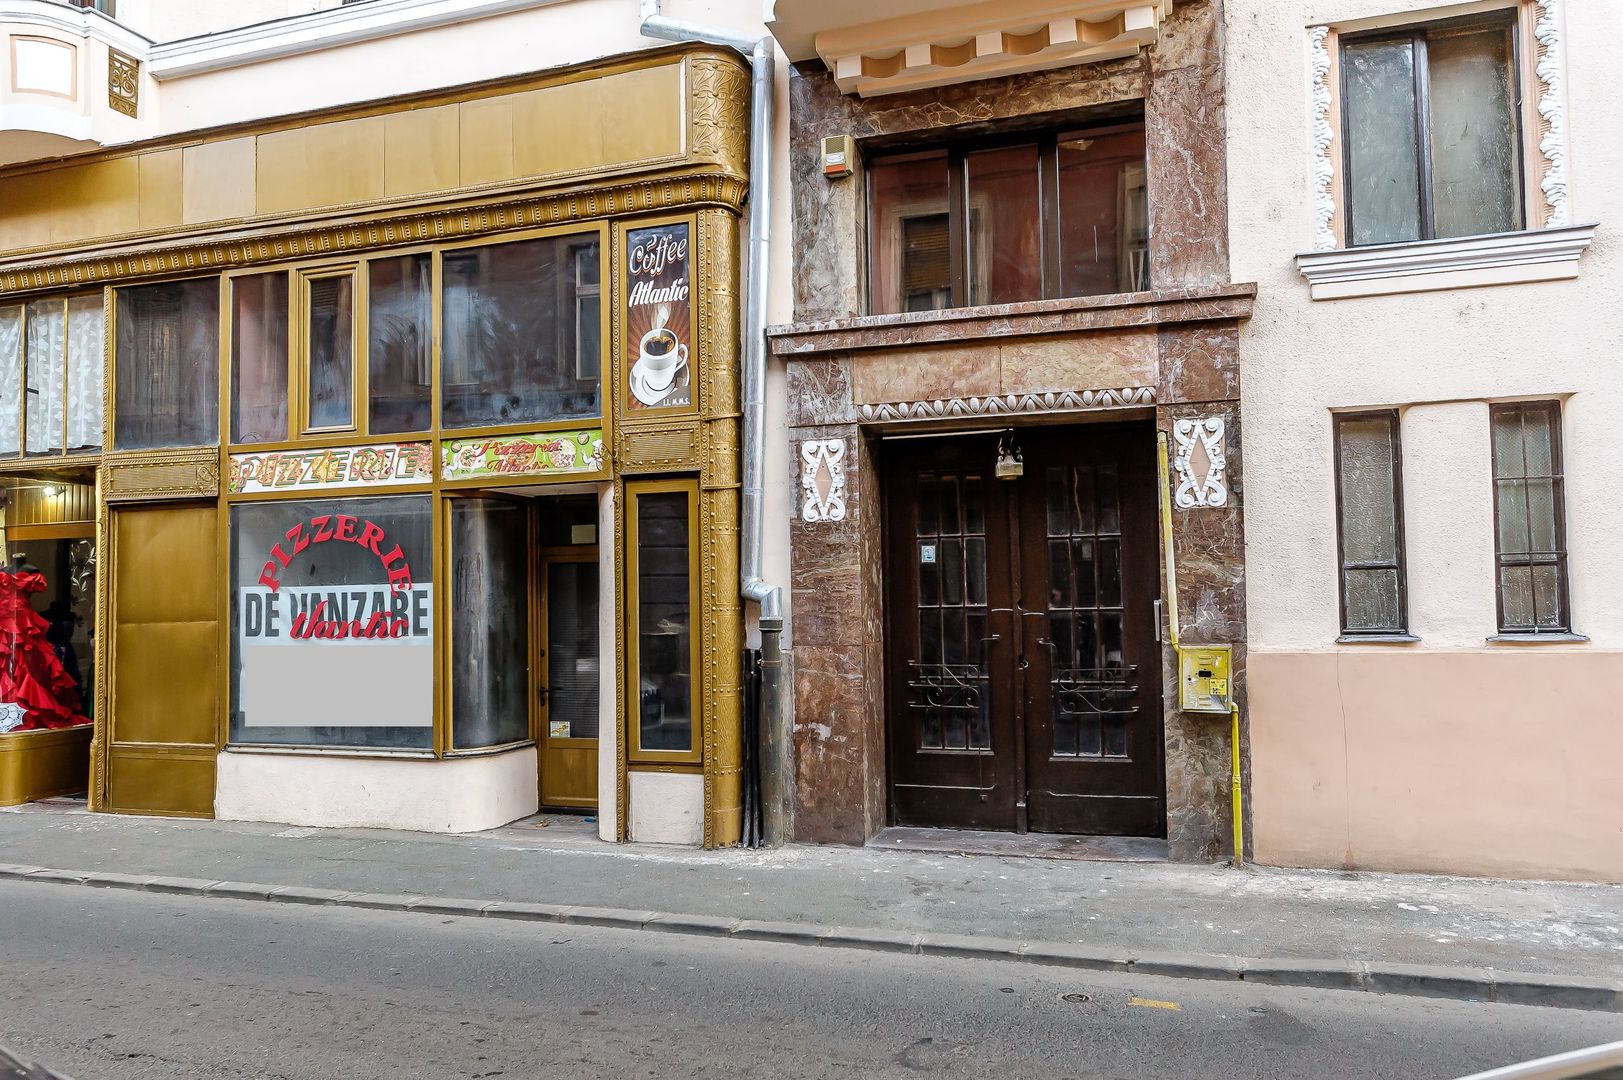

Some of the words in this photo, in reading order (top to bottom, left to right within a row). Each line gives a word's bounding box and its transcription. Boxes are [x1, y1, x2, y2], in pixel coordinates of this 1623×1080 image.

[629, 234, 687, 275] Coffee
[628, 278, 689, 308] Atlantic
[238, 447, 420, 489] PIZZERIE
[474, 438, 561, 457] Pizzeria
[257, 513, 413, 597] PIZZERIE
[245, 592, 280, 637] DE
[289, 590, 428, 637] VANZARE
